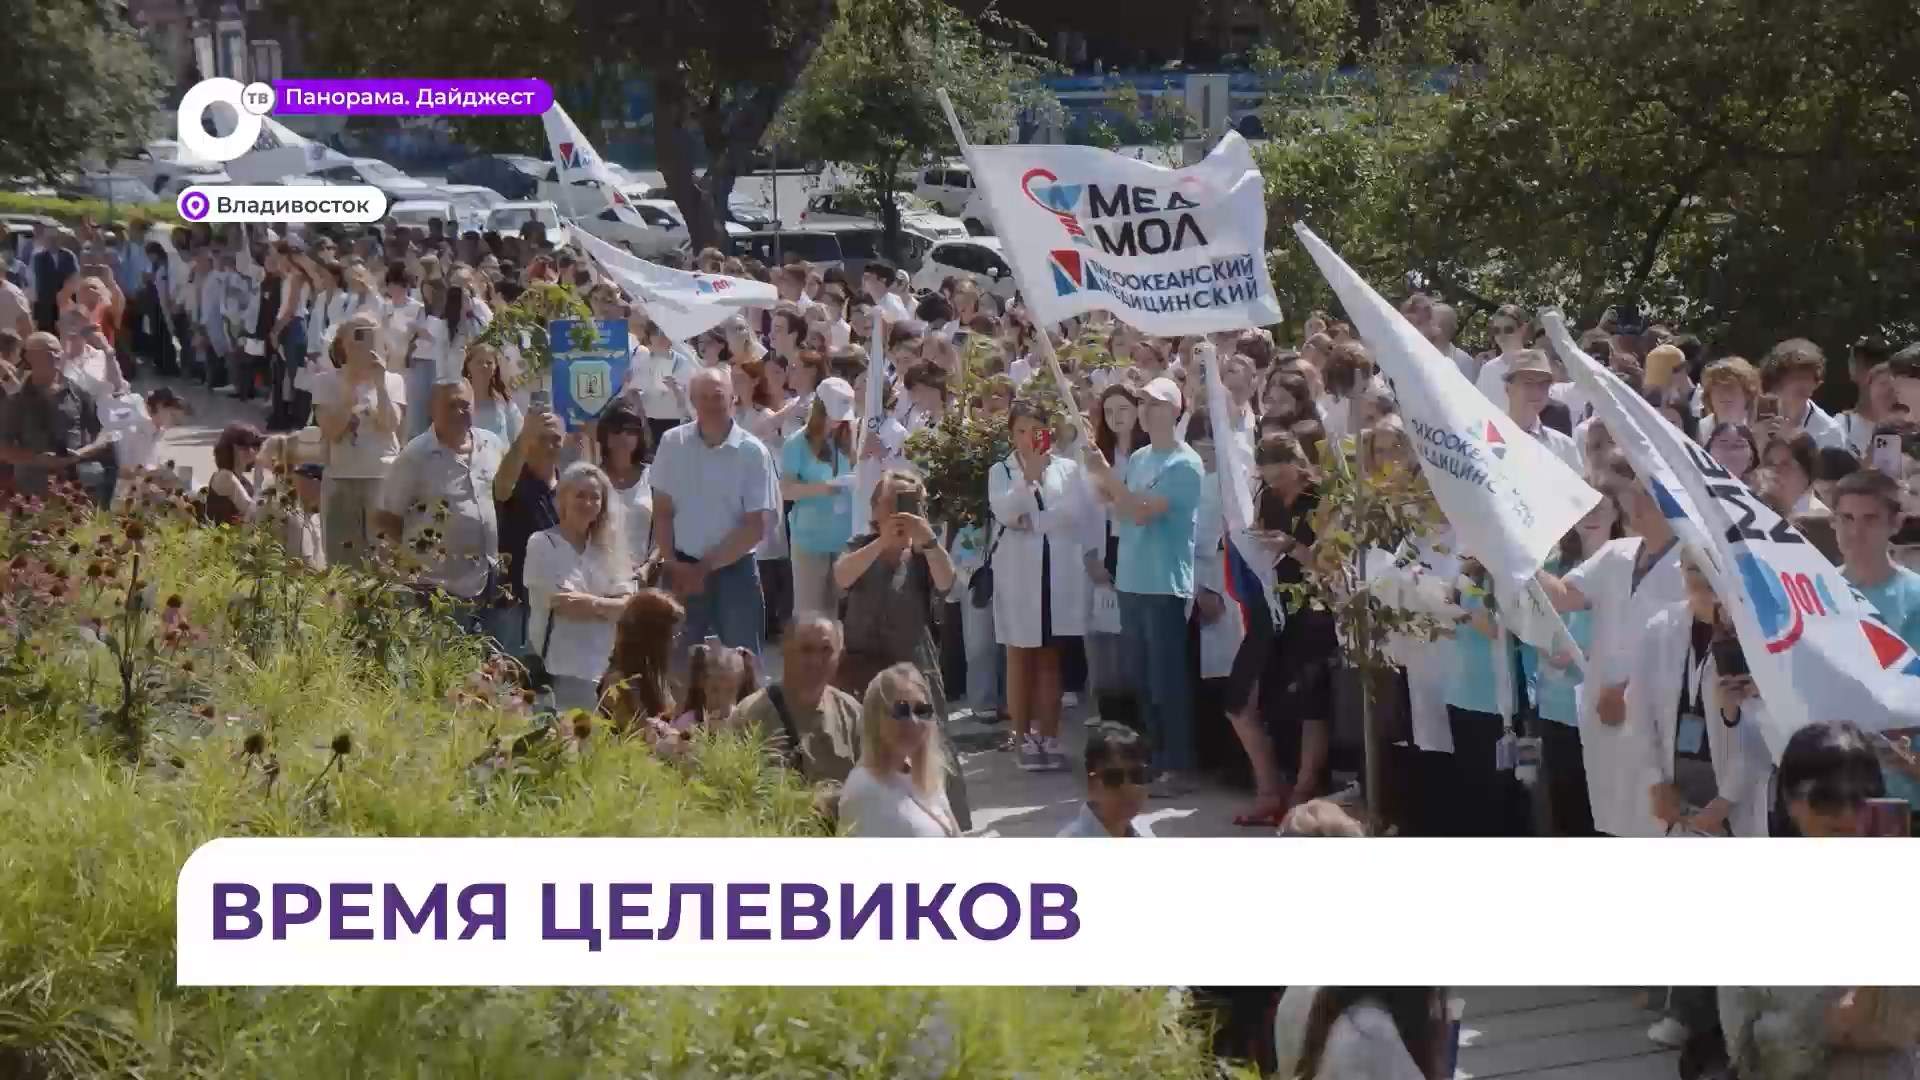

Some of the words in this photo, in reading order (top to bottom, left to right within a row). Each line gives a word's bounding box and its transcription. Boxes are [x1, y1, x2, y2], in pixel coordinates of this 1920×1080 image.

[1088, 183, 1201, 218] МЕД
[1094, 212, 1209, 256] МОЛ
[1090, 253, 1254, 292] ООКЕАНСКИЙ
[1101, 278, 1258, 314] ДИЦИНСКИЙ
